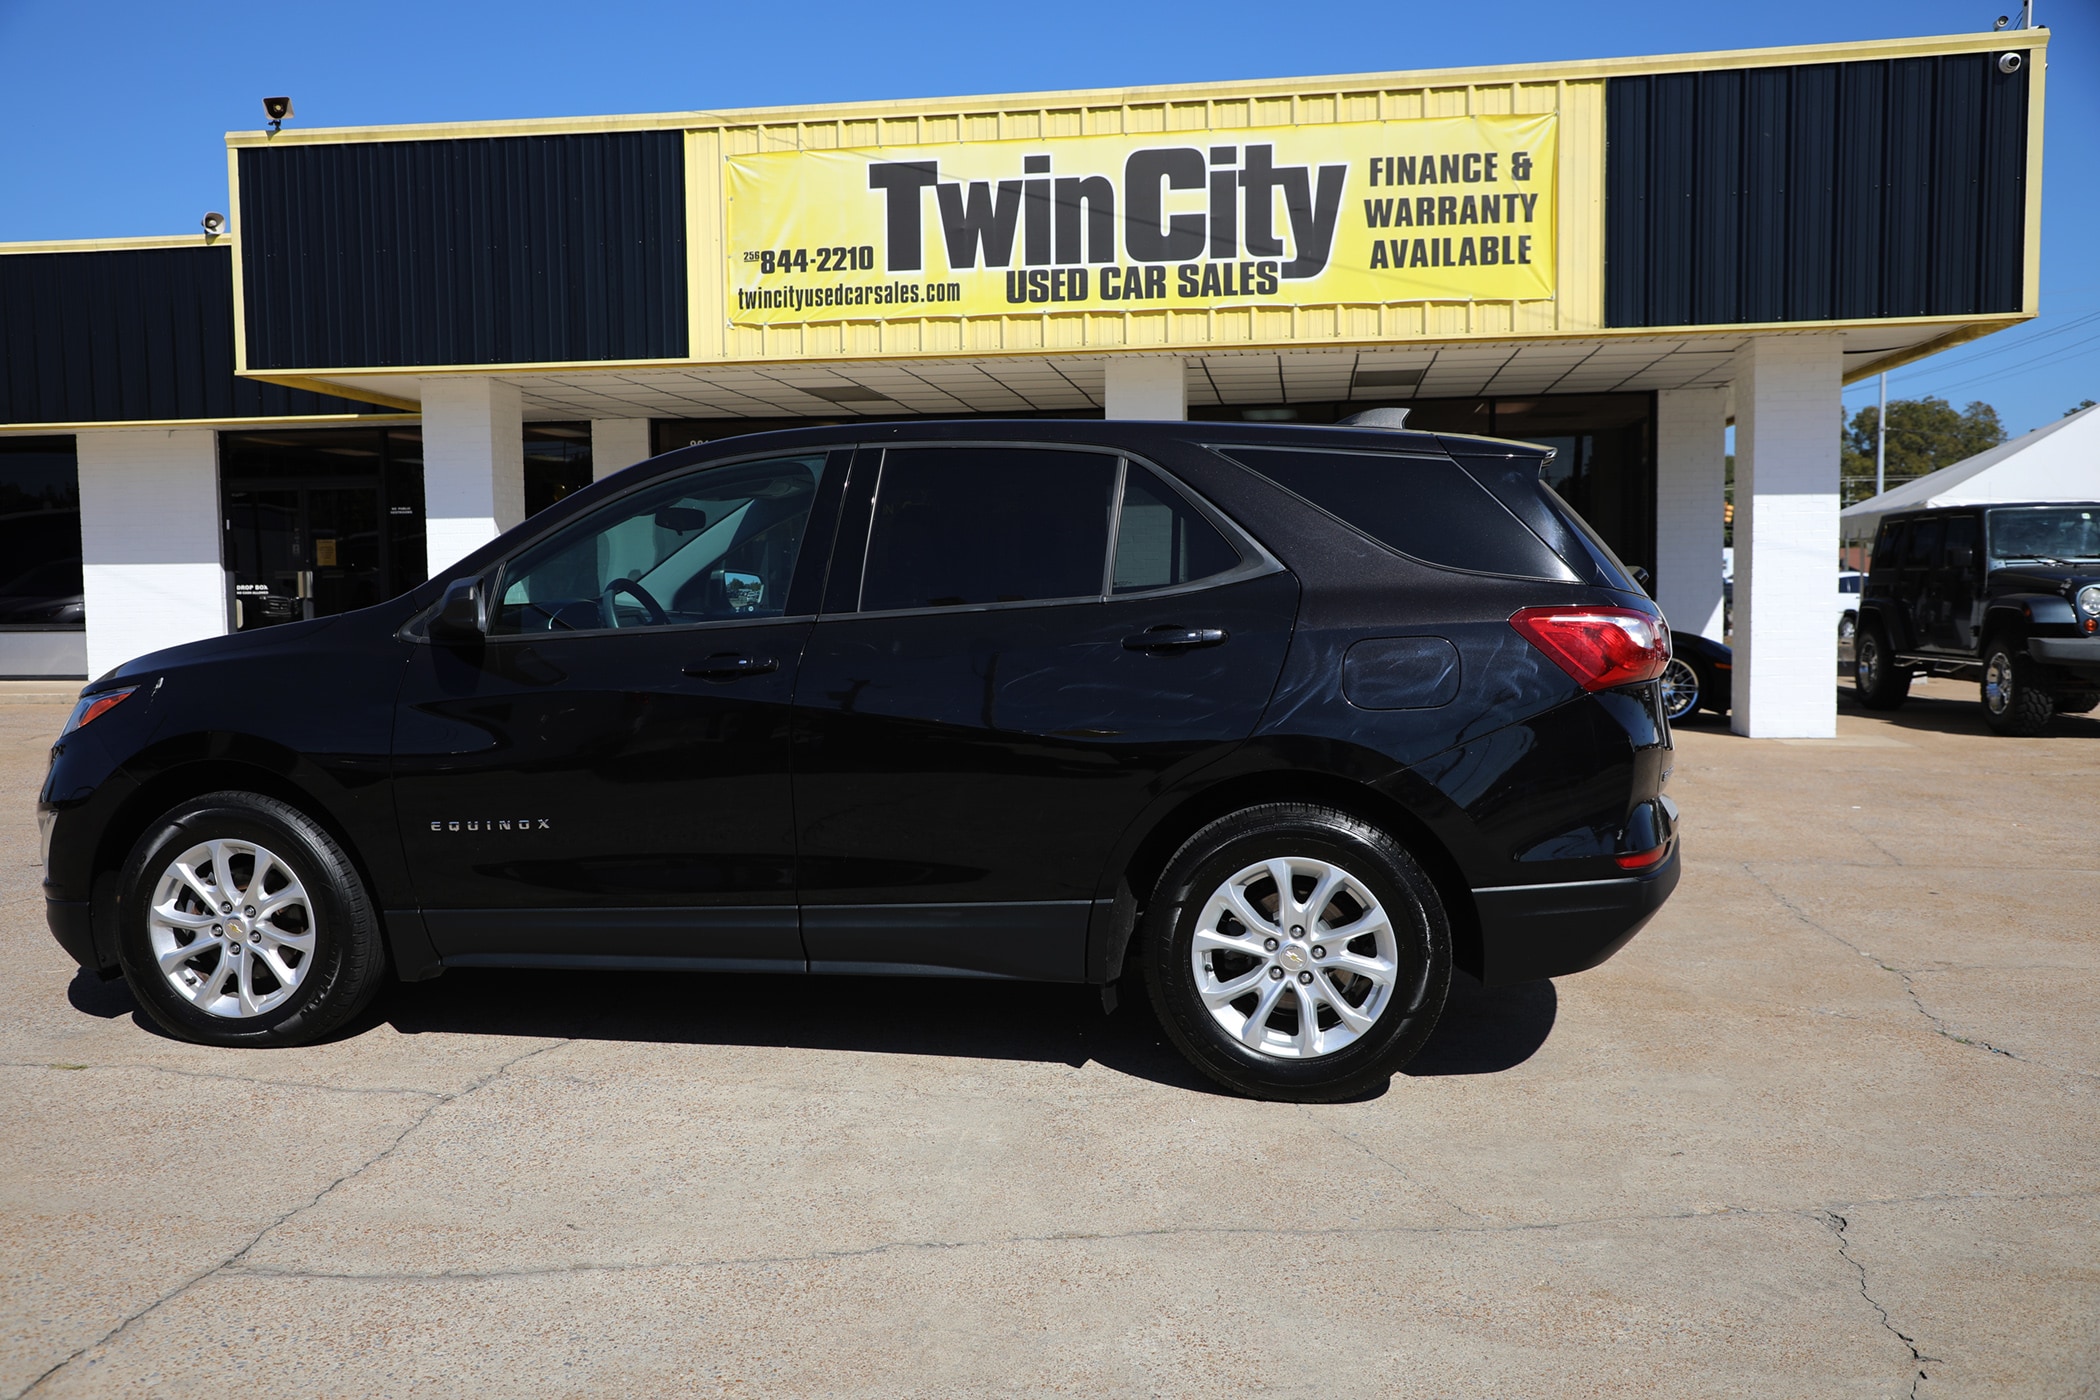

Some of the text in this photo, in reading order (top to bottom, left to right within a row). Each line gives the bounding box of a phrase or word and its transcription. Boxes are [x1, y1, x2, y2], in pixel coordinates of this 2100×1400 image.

[1369, 151, 1533, 187] FINANCE &
[868, 144, 1348, 279] TwinCity
[1363, 193, 1538, 229] WARRANTY
[1369, 235, 1532, 270] AVAILABLE
[738, 280, 961, 312] twincityusedcarsales.com
[1006, 260, 1278, 304] USED CAR SALES
[430, 819, 550, 832] EQUINOX
